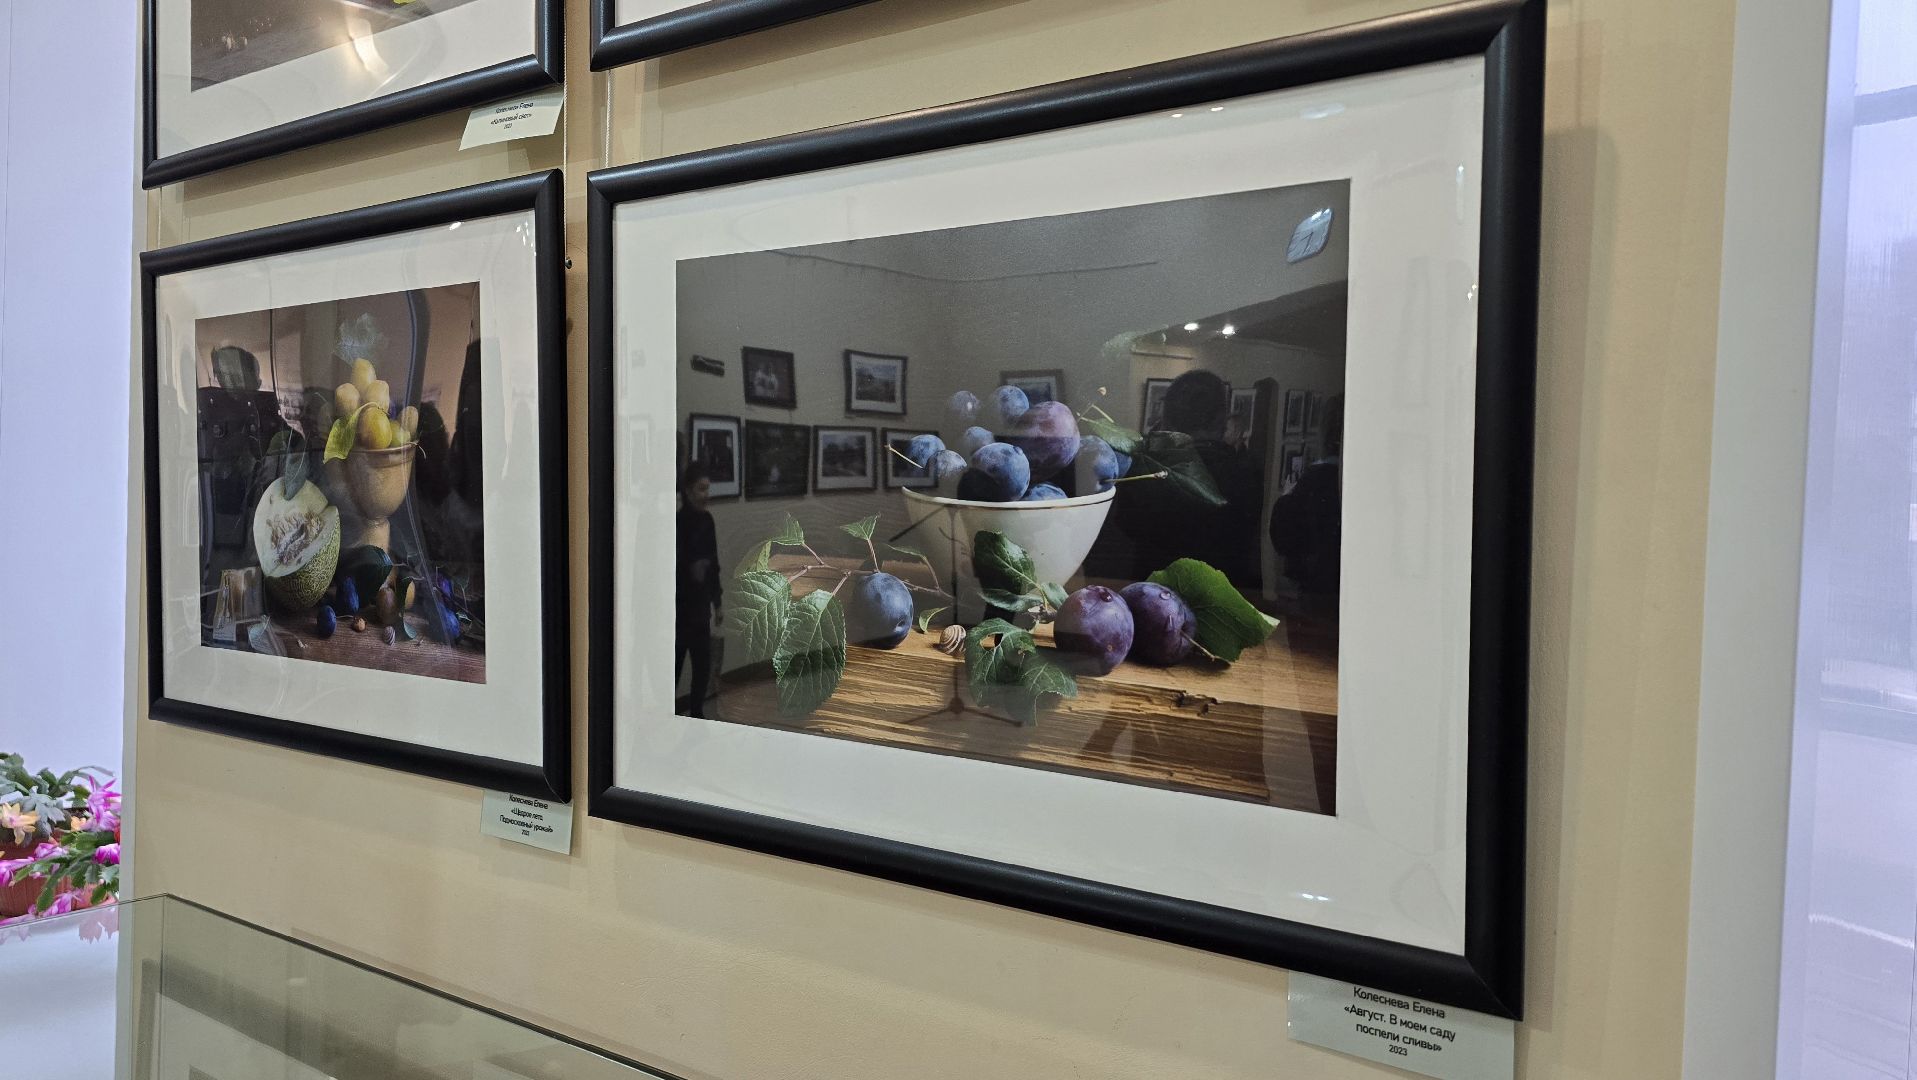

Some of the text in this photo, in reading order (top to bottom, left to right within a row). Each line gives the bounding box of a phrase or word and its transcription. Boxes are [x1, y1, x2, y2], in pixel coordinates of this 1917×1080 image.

[1353, 986, 1446, 1019] Колеснева Елена
[1344, 1004, 1456, 1042] «Август. В моем саду
[1356, 1023, 1442, 1052] поспели сливы»
[1388, 1044, 1408, 1056] 2023
